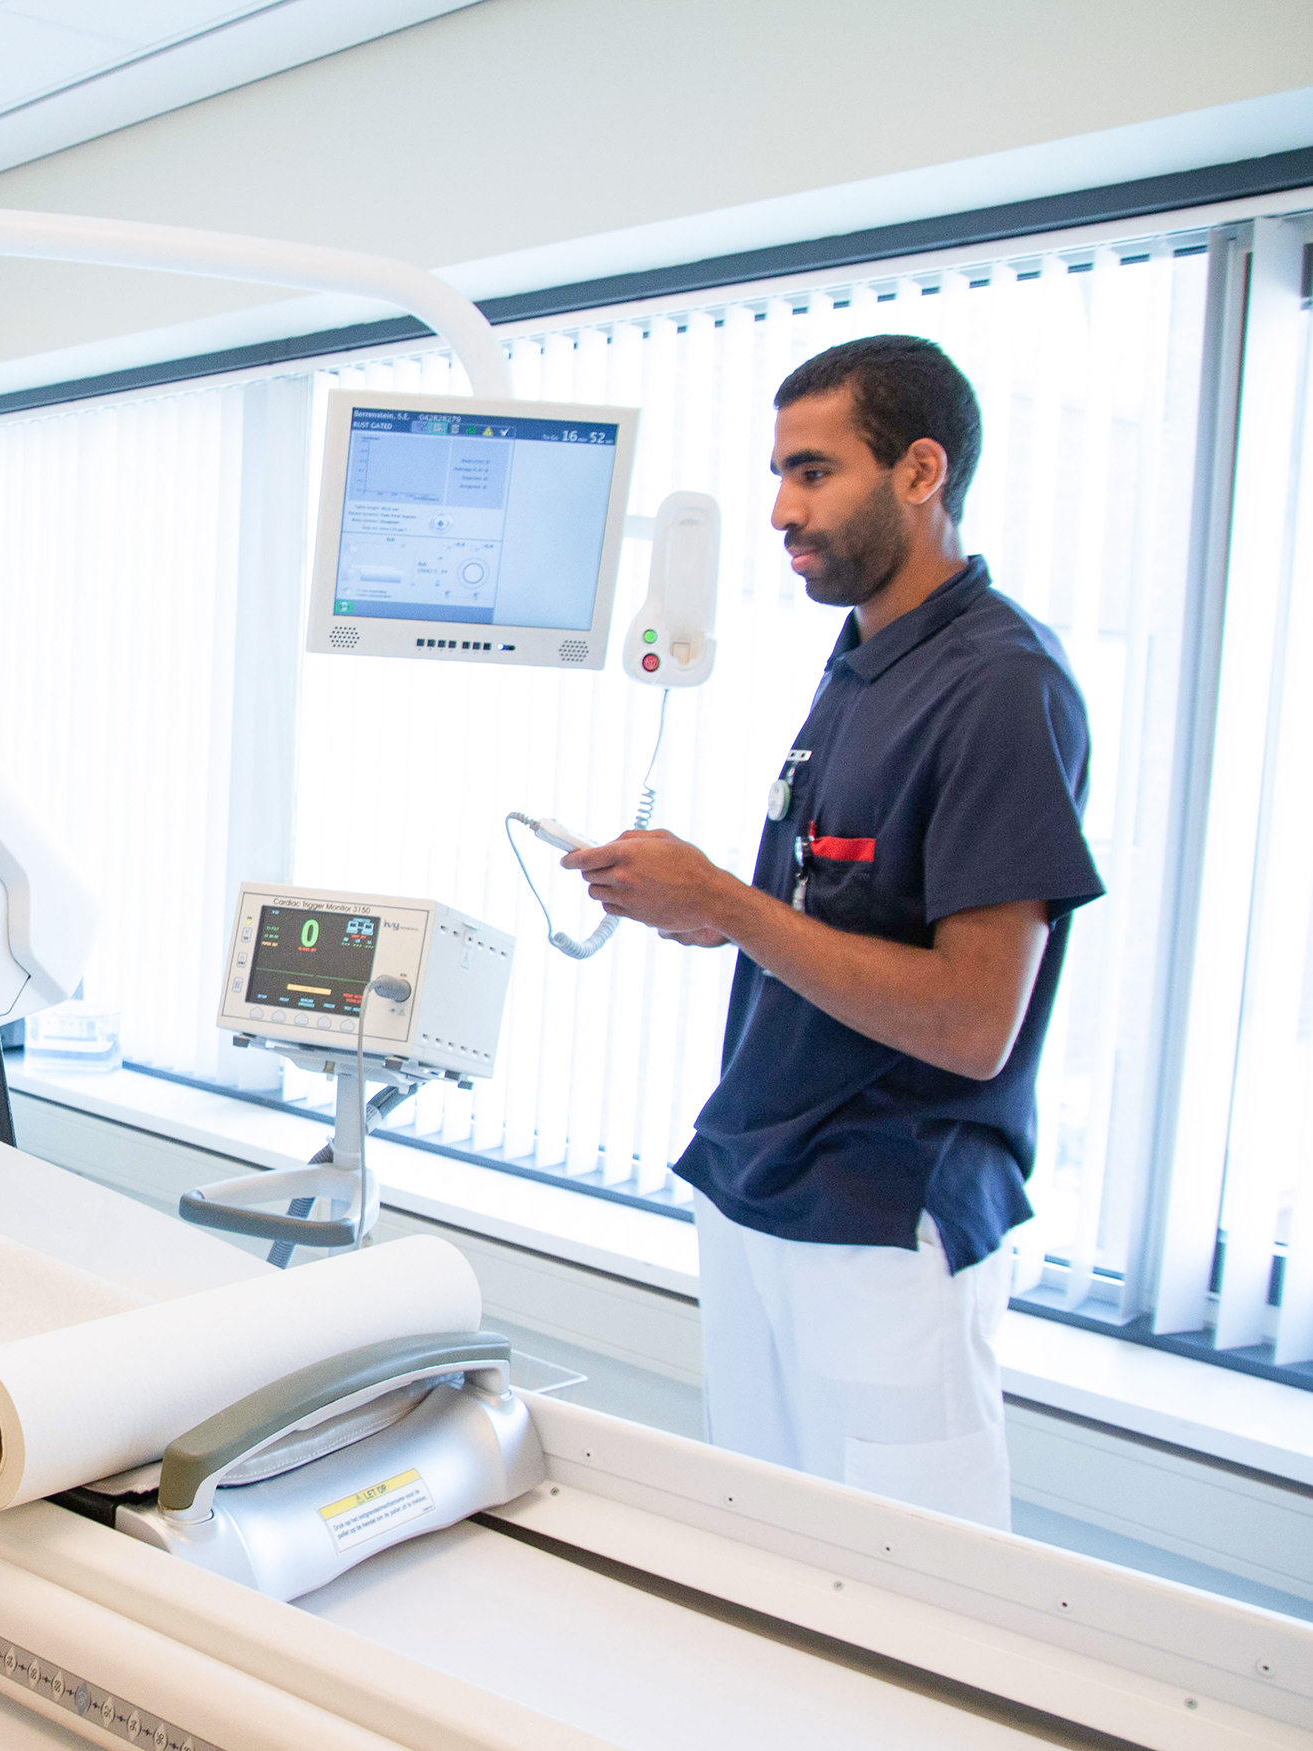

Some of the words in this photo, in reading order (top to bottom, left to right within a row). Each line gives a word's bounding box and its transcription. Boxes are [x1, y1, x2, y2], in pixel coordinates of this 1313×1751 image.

[370, 422, 394, 430] GATED
[562, 430, 578, 442] 16
[589, 431, 606, 444] 52
[273, 898, 301, 907] Cardiac
[302, 900, 325, 912] Trigger
[325, 902, 352, 912] Monitor
[353, 906, 372, 914] 3150
[300, 918, 320, 948] 0
[363, 1488, 377, 1500] LET
[376, 1484, 387, 1494] OP
